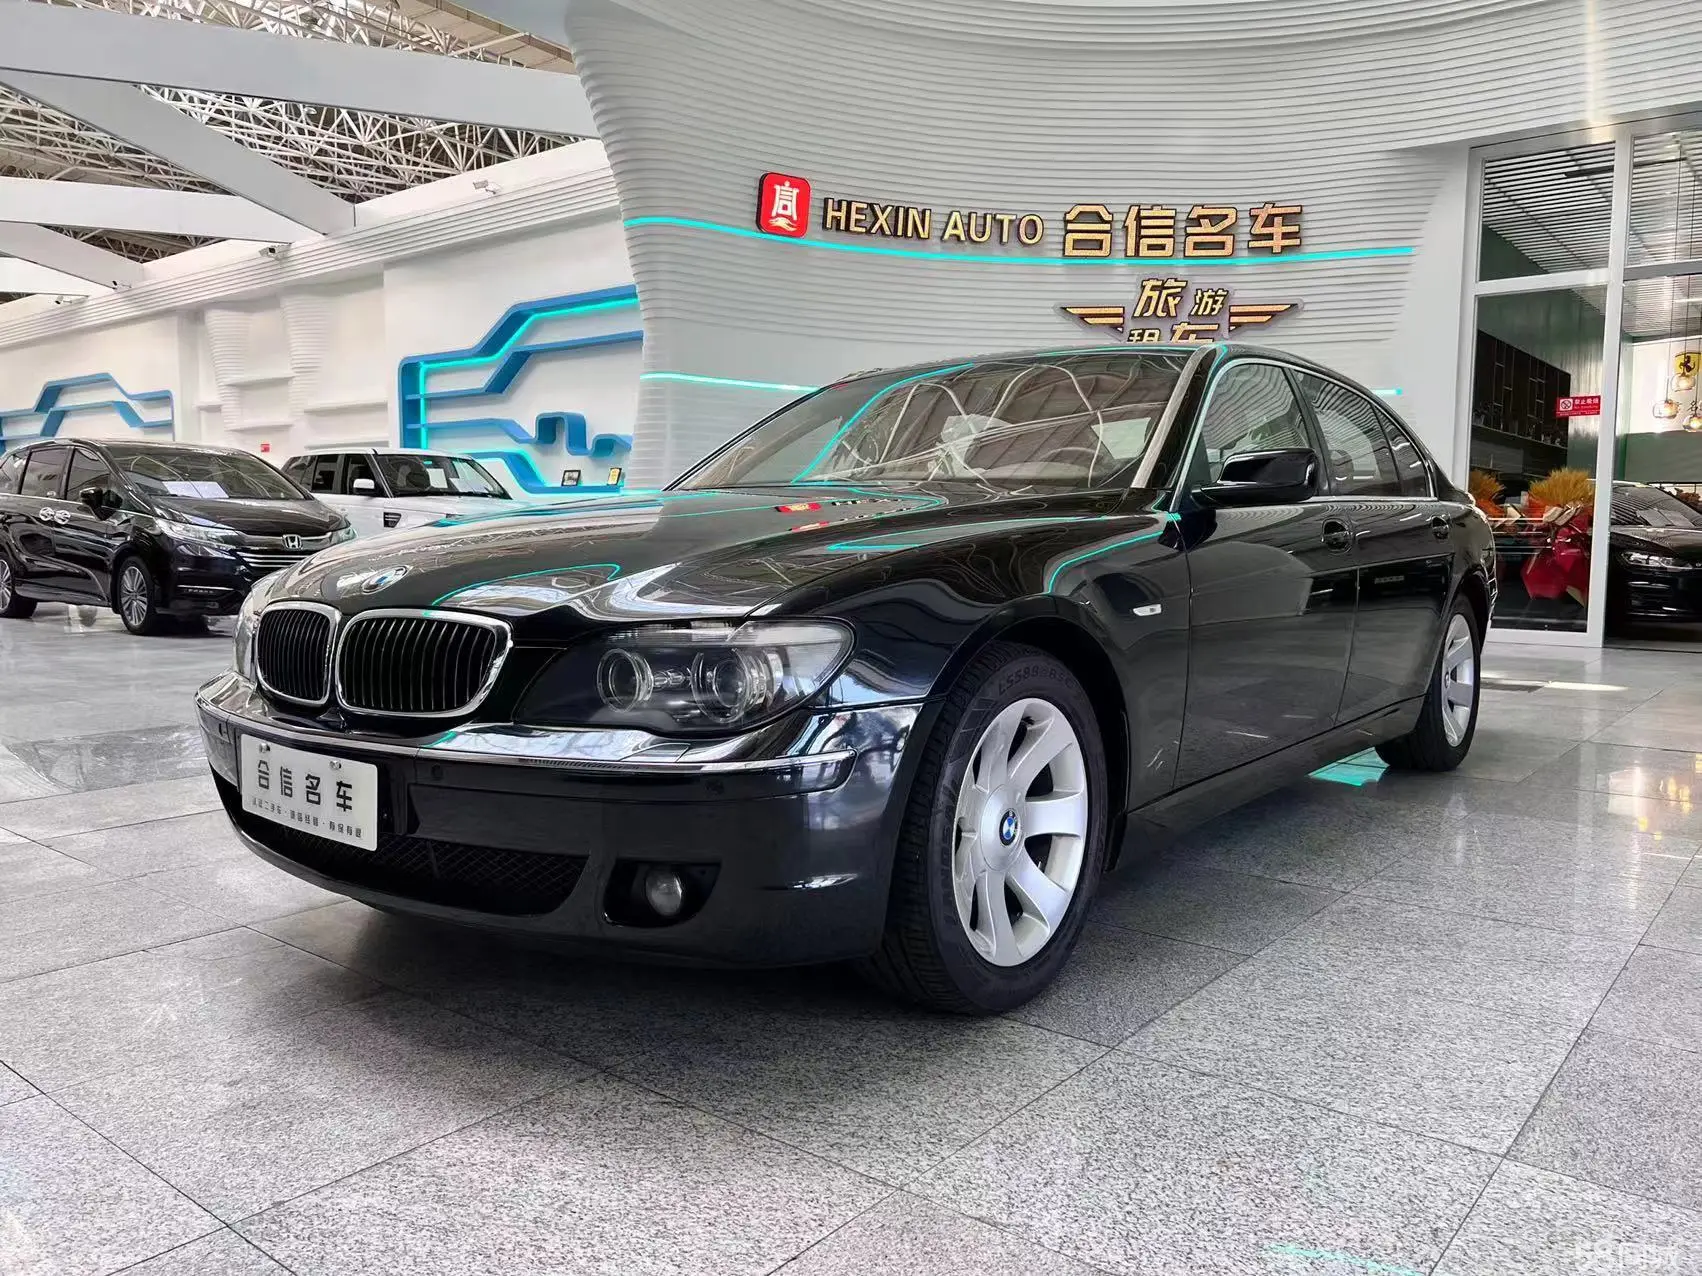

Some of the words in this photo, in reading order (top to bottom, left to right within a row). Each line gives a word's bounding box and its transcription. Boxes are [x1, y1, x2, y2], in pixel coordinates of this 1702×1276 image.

[823, 197, 932, 240] HEXIN
[941, 210, 1045, 246] AUTO
[1063, 203, 1303, 257] 合信名车
[1132, 278, 1229, 319] 旅游
[258, 759, 353, 812] 合信名车
